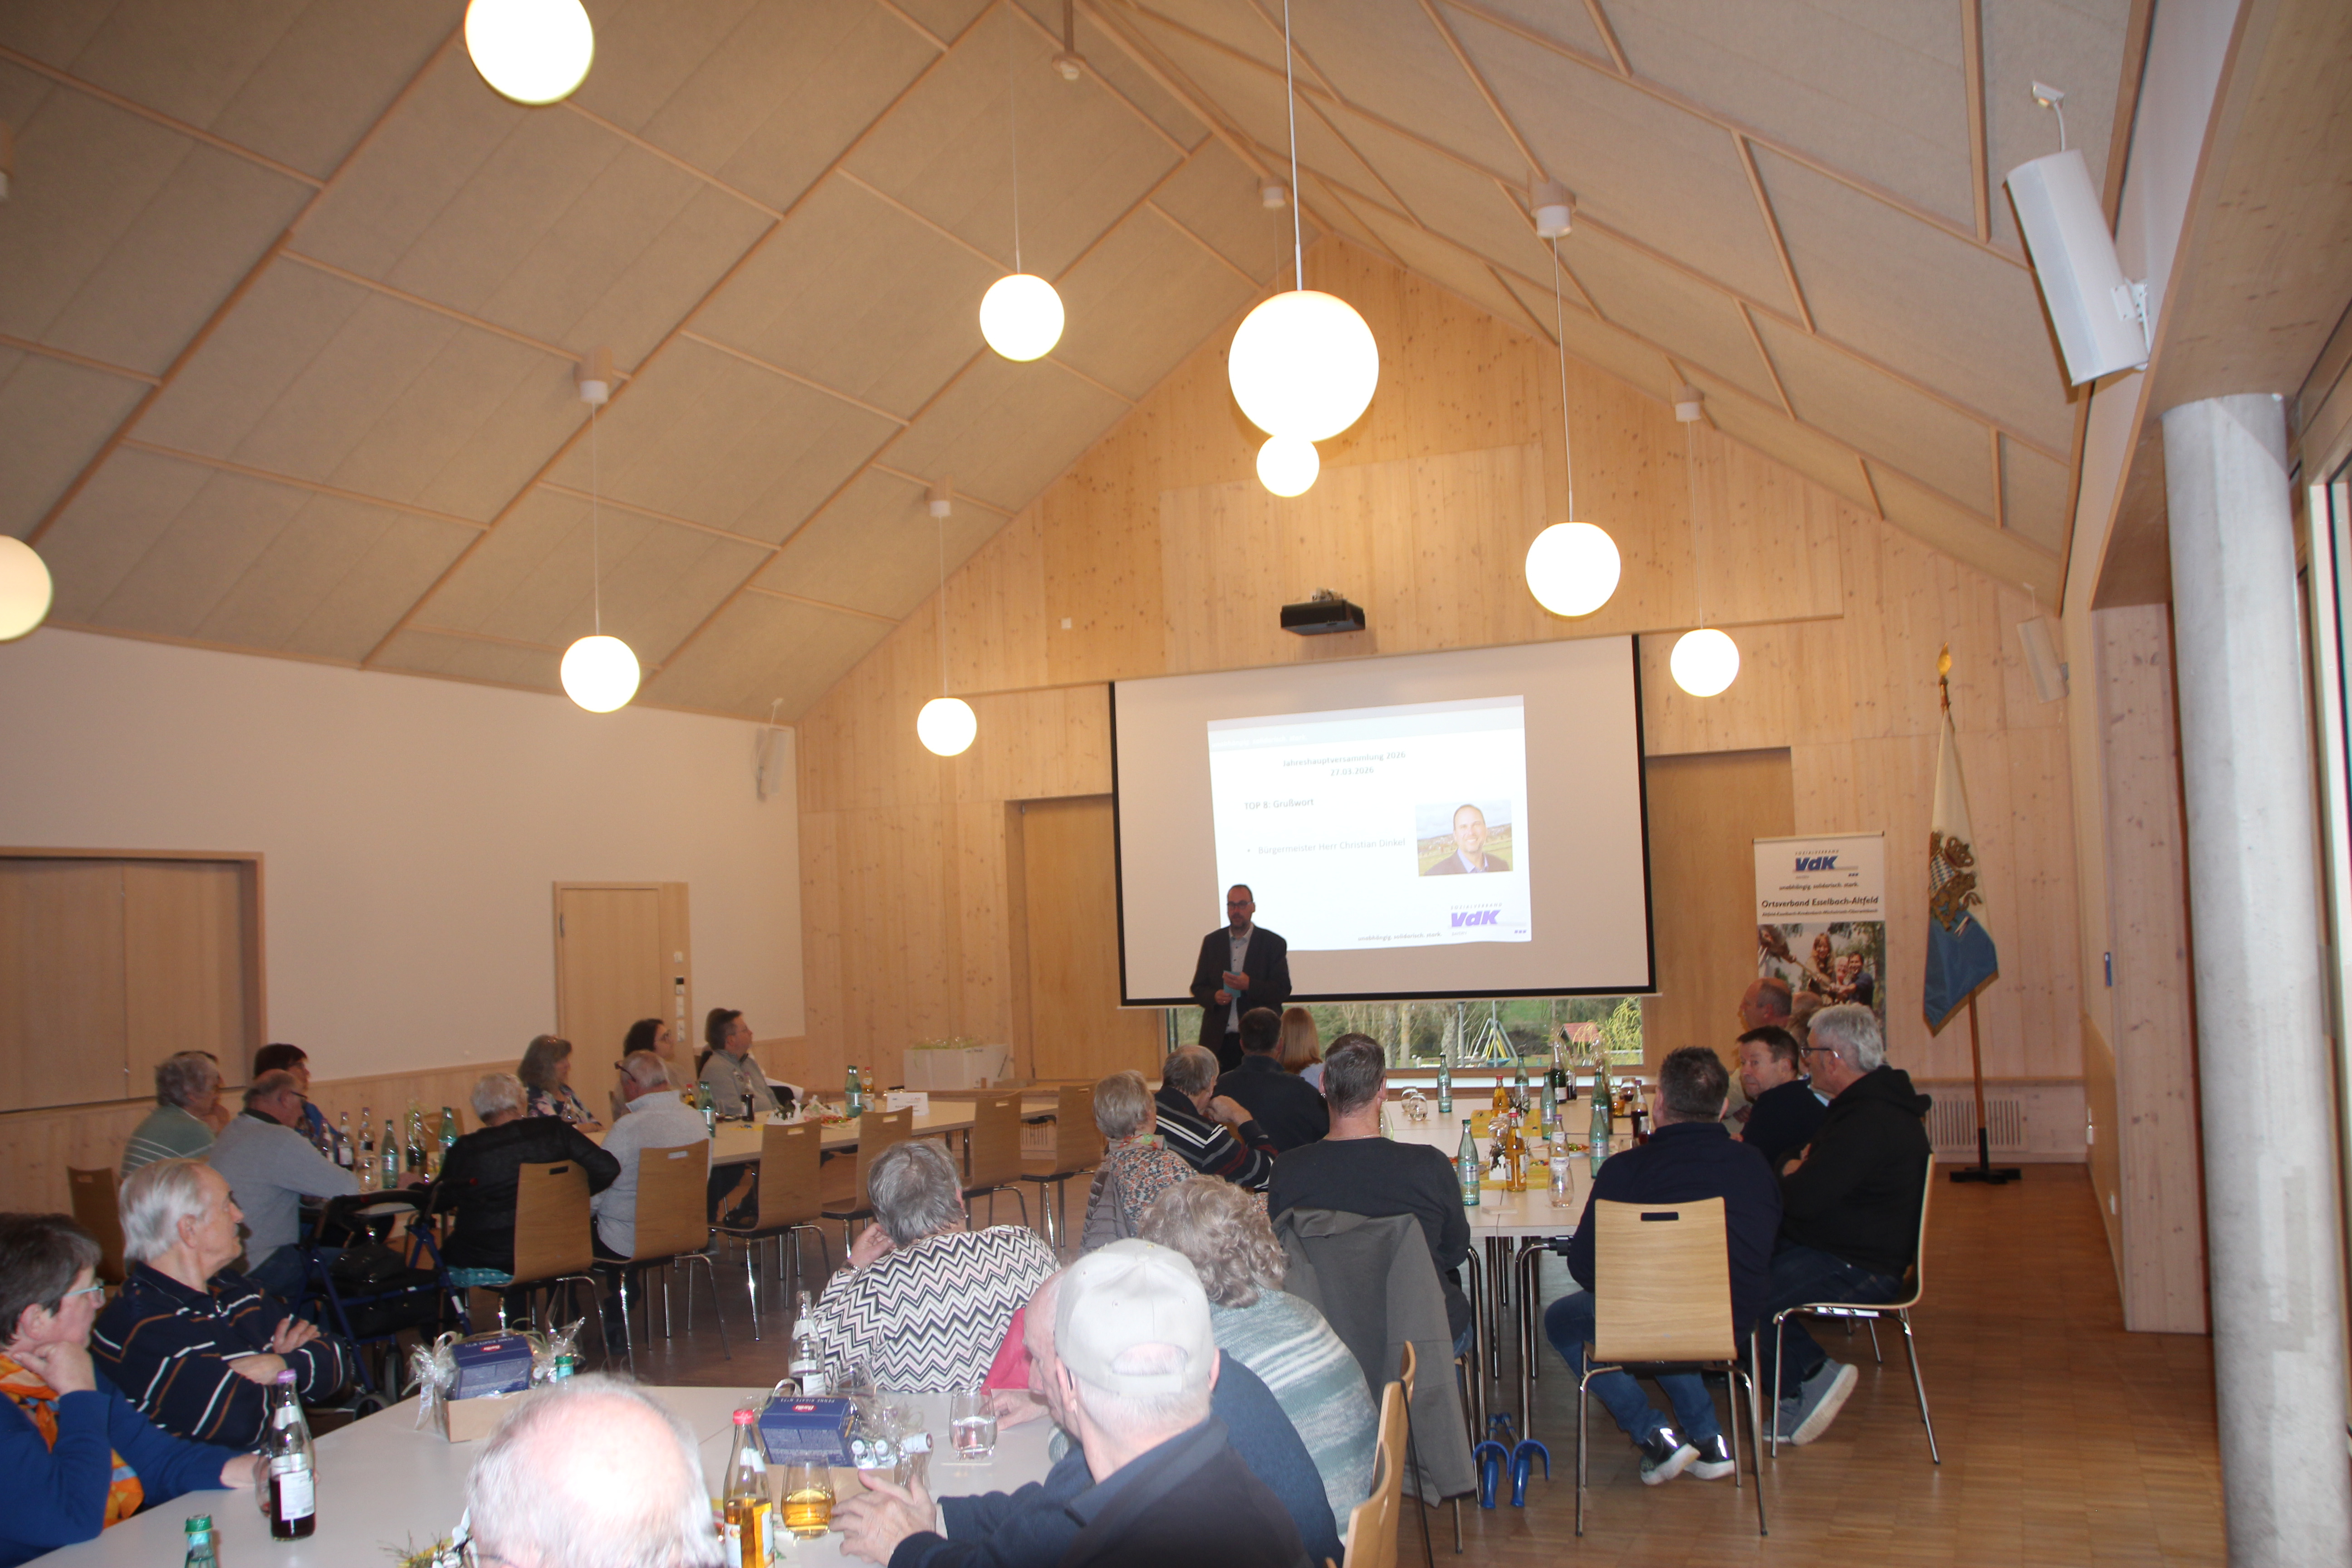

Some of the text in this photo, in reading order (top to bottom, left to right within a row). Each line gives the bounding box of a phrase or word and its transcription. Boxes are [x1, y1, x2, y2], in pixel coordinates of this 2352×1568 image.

[1283, 750, 1406, 767] Jahreshauptversammlung 2026
[1330, 767, 1374, 776] 27.03.2026
[1245, 802, 1260, 810] TOP
[1273, 799, 1314, 808] Grußwort
[1258, 838, 1406, 856] Bürgermeister Herr Christian Dinkel
[1795, 856, 1838, 871] VdK
[1762, 897, 1878, 907] Ortsverband Esselbach-Altfeld
[1451, 910, 1501, 926] VdK
